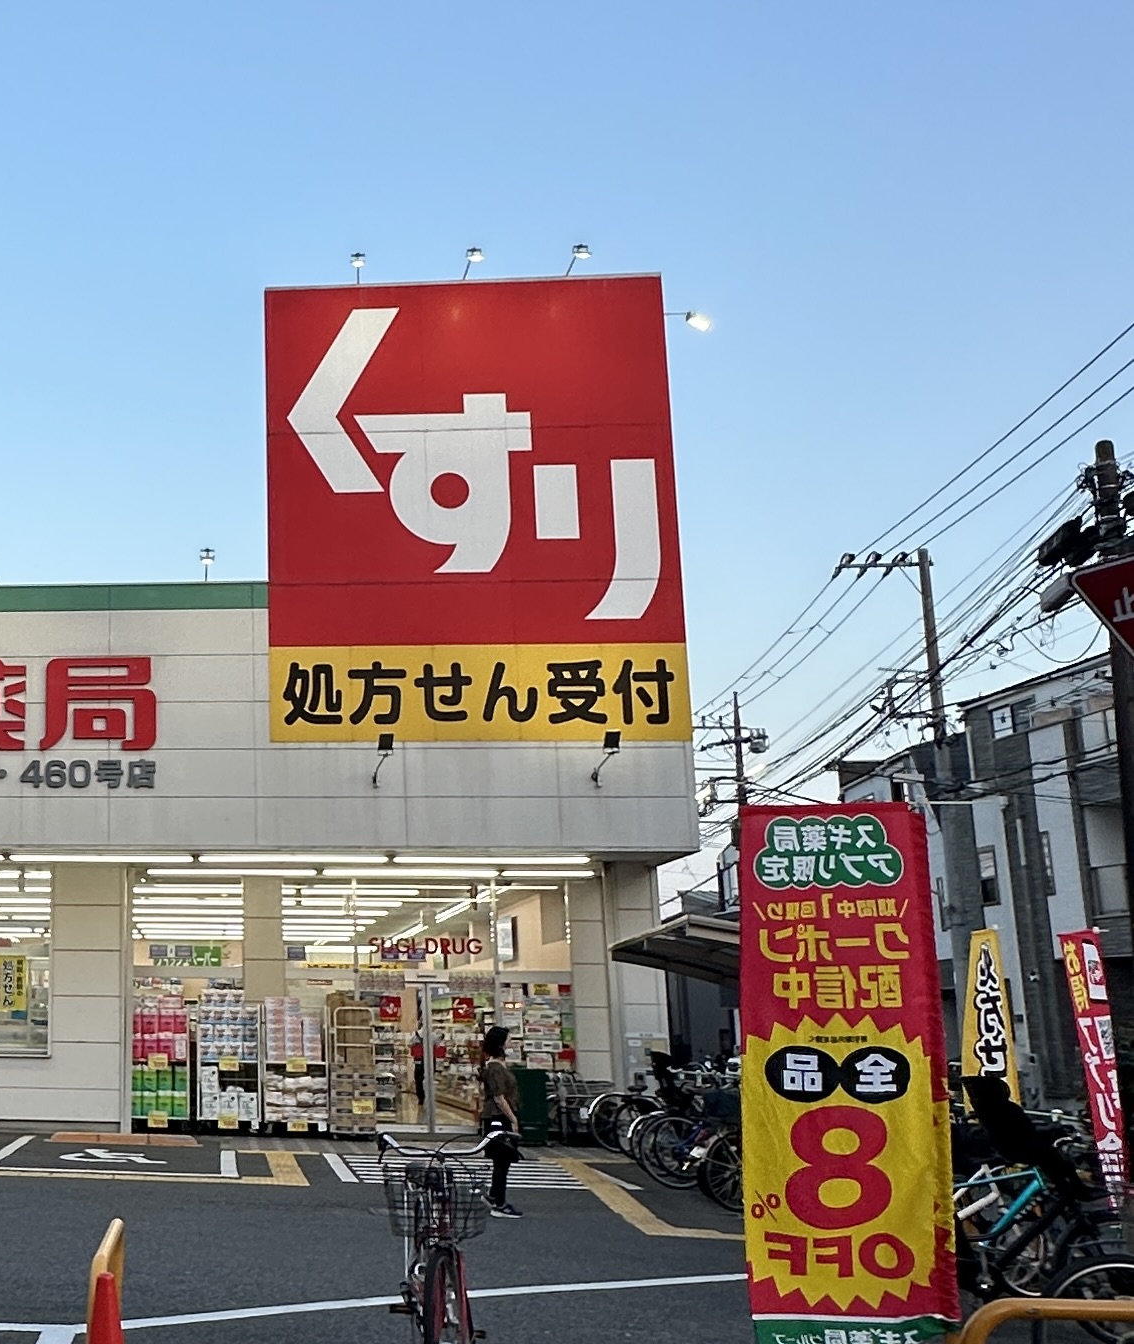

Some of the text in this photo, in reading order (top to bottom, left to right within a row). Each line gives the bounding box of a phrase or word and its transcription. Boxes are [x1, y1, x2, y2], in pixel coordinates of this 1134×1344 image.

[287, 306, 662, 621] くすり
[283, 659, 675, 726] 処方せん受付
[368, 937, 483, 955] SUGI DRUG
